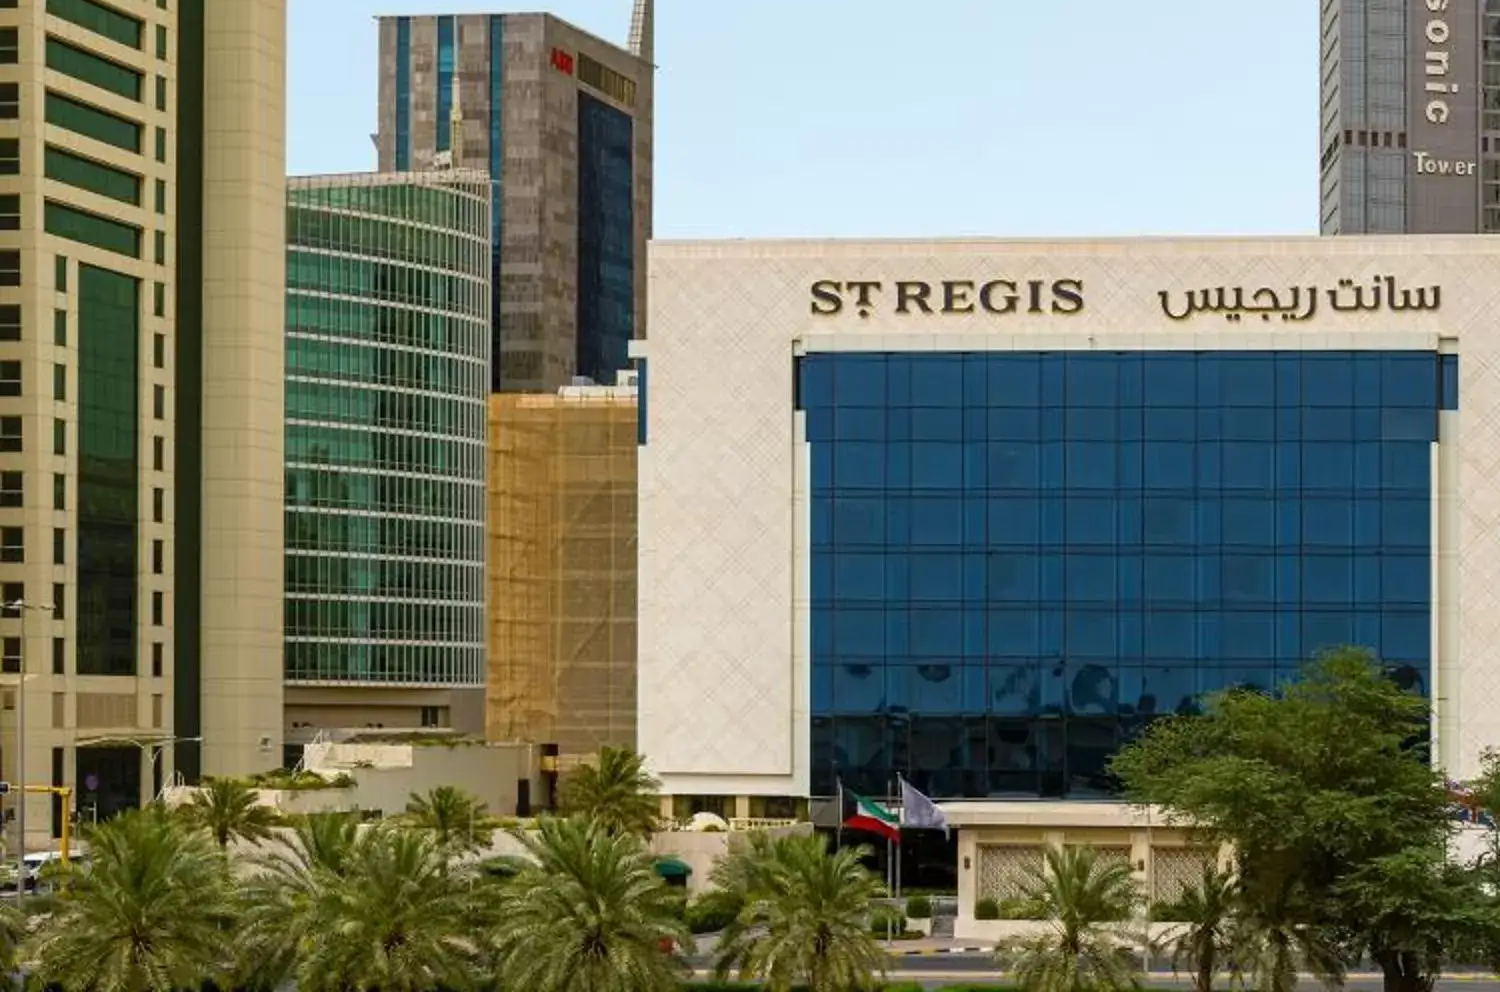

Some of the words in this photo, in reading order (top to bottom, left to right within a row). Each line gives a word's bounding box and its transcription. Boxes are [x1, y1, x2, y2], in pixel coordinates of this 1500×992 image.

[1413, 151, 1477, 176] Tower
[894, 279, 1084, 315] REGIS
[1157, 286, 1317, 321] ريجيس
[1326, 275, 1441, 312] سانت
